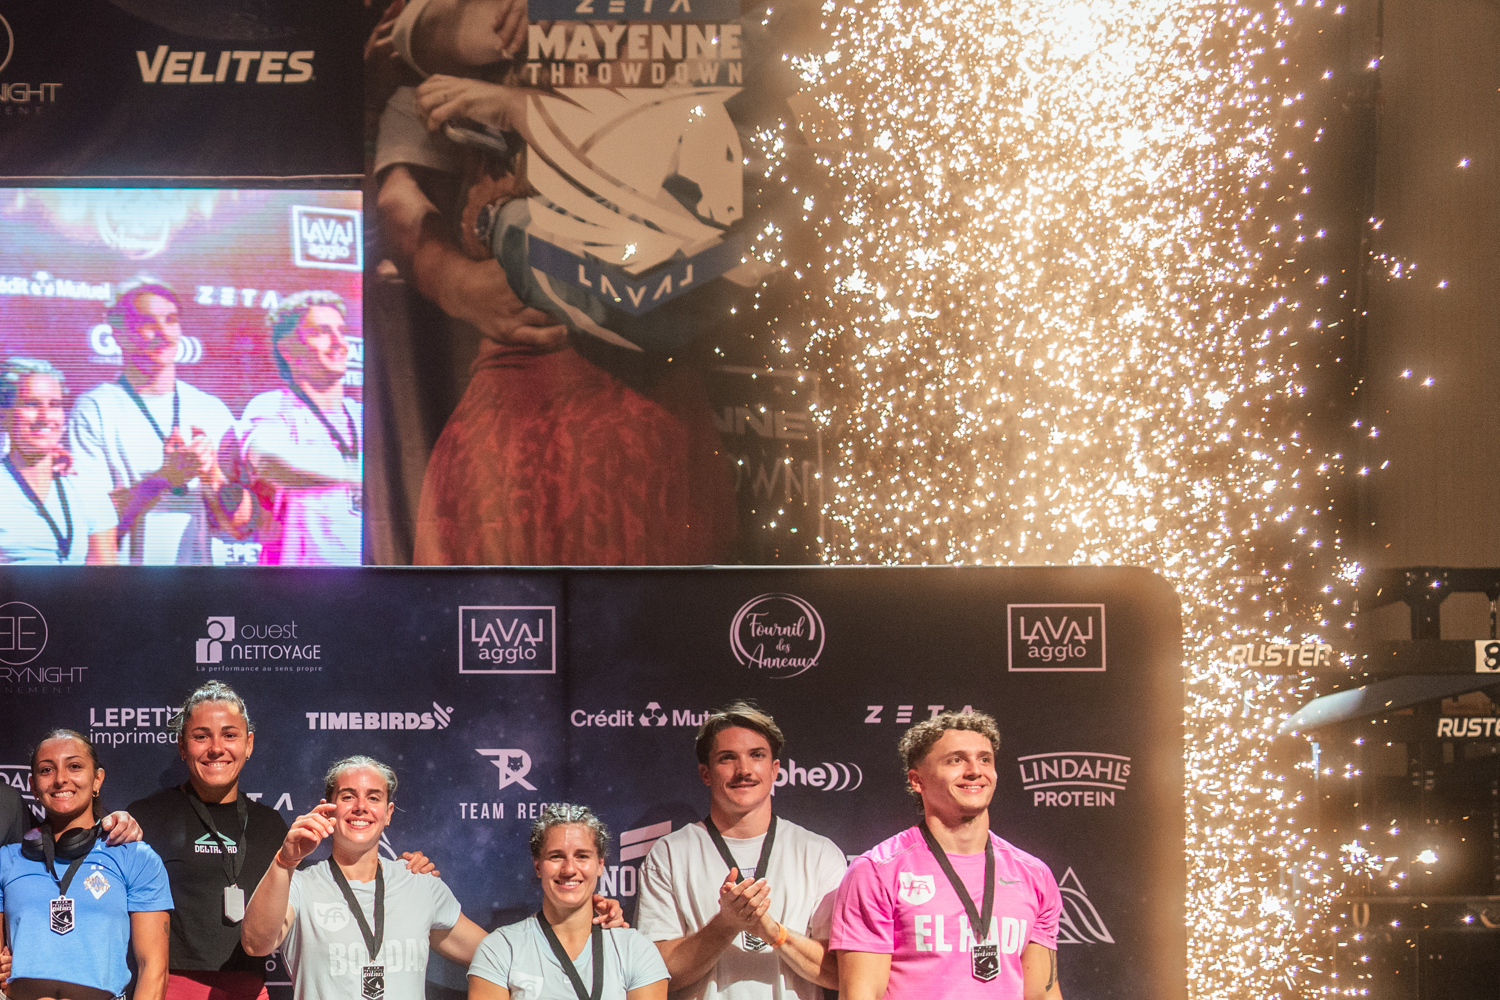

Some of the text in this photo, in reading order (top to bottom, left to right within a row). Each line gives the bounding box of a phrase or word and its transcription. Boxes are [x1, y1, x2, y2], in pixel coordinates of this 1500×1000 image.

[528, 25, 742, 60] MAYENNE
[136, 45, 315, 84] VELITES
[528, 62, 743, 85] THROWDOWN
[195, 285, 280, 309] ZETA
[241, 620, 298, 639] ouest
[746, 611, 806, 638] Fournil
[230, 643, 322, 660] NETTOYAGE
[478, 645, 536, 664] agglo
[776, 638, 790, 653] des
[1028, 643, 1086, 661] agglo
[1228, 644, 1332, 666] RUSTER
[748, 643, 819, 669] Anneaux
[207, 665, 260, 673] performance
[90, 705, 183, 727] LEPETI
[306, 712, 435, 730] TIMEBIRDS
[570, 708, 634, 727] Crédit
[90, 728, 179, 748] imprimeu
[1034, 791, 1115, 807] PROTEIN
[459, 803, 504, 820] TEAM
[914, 914, 952, 951] EL
[328, 938, 430, 977] BODAS
